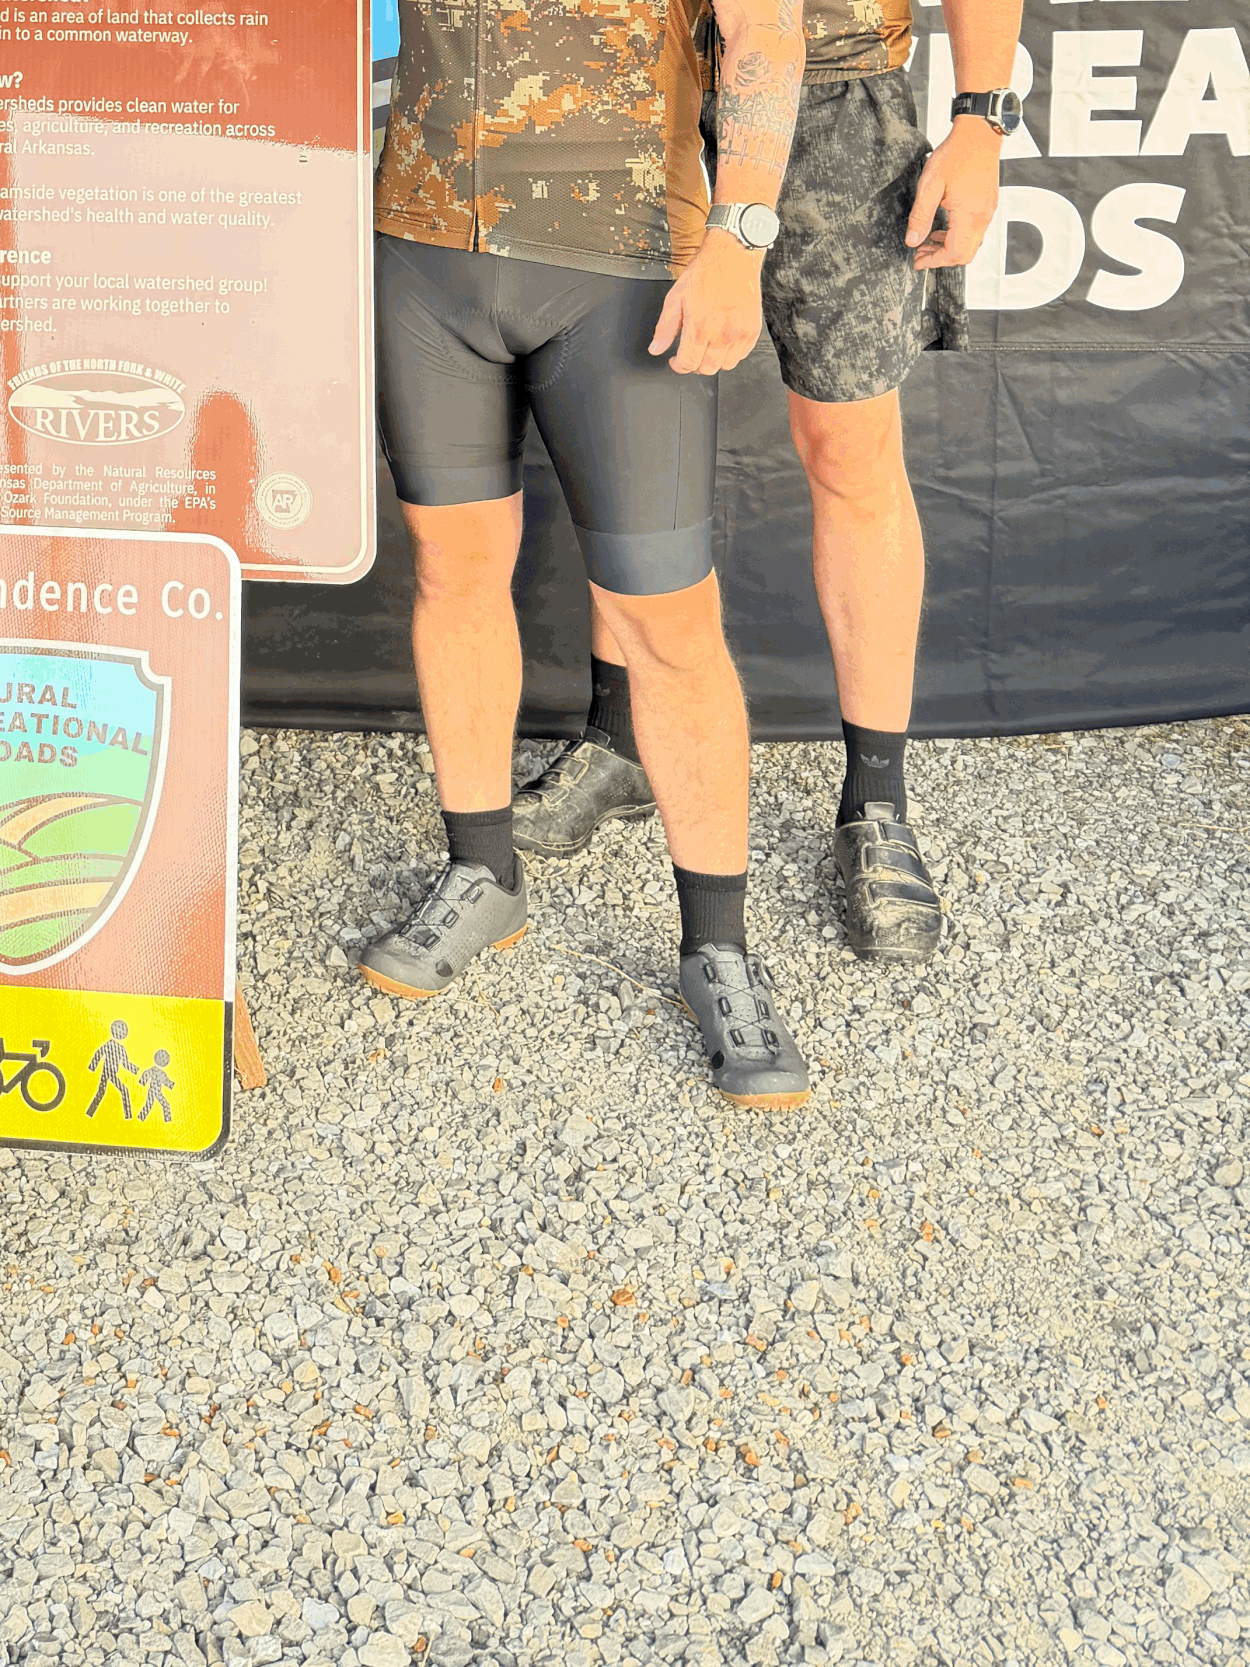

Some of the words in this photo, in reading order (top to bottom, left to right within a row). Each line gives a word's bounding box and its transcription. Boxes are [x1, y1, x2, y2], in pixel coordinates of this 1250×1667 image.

[13, 7, 25, 22] is
[29, 10, 47, 22] an
[51, 11, 84, 23] area
[87, 8, 103, 24] of
[107, 8, 138, 24] land
[143, 8, 173, 24] that
[176, 9, 235, 25] collects
[239, 10, 268, 25] rain
[15, 26, 30, 40] to
[33, 29, 43, 40] a
[46, 29, 111, 42] common
[115, 28, 192, 46] waterway.
[58, 96, 122, 116] provides
[125, 96, 166, 113] clean
[170, 99, 214, 113] water
[217, 98, 239, 114] for
[7, 364, 48, 391] FRIENDS
[49, 361, 61, 373] OF
[63, 359, 81, 371] THE
[83, 358, 117, 370] NORTH
[118, 360, 144, 376] FORK
[144, 367, 152, 378] &
[154, 368, 187, 394] WHITE
[34, 408, 160, 442] RIVERS
[161, 580, 224, 622] Co.
